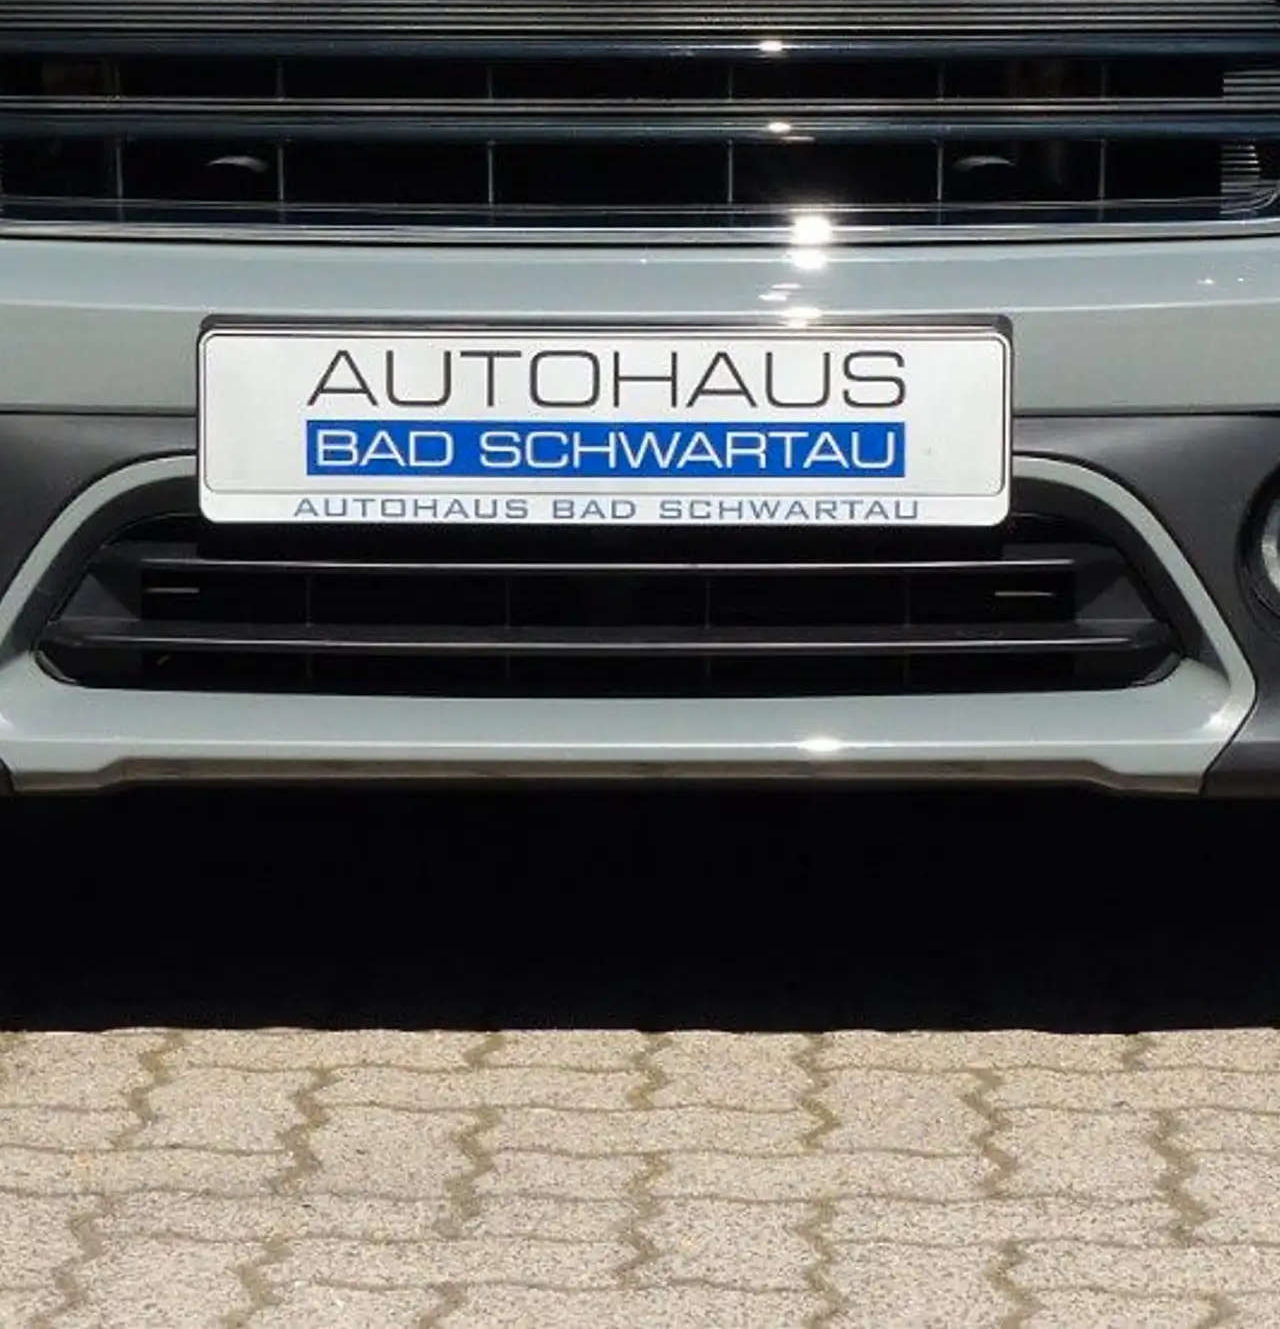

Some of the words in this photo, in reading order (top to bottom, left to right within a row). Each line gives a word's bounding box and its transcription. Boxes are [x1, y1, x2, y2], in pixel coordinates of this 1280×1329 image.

[307, 349, 907, 409] AUTOHAUS
[316, 428, 455, 469] BAD
[478, 429, 896, 471] SCHWARTAU
[293, 497, 530, 521] AUTOHAUS
[552, 498, 637, 521] BAD
[658, 499, 920, 521] SCHWARTAU
